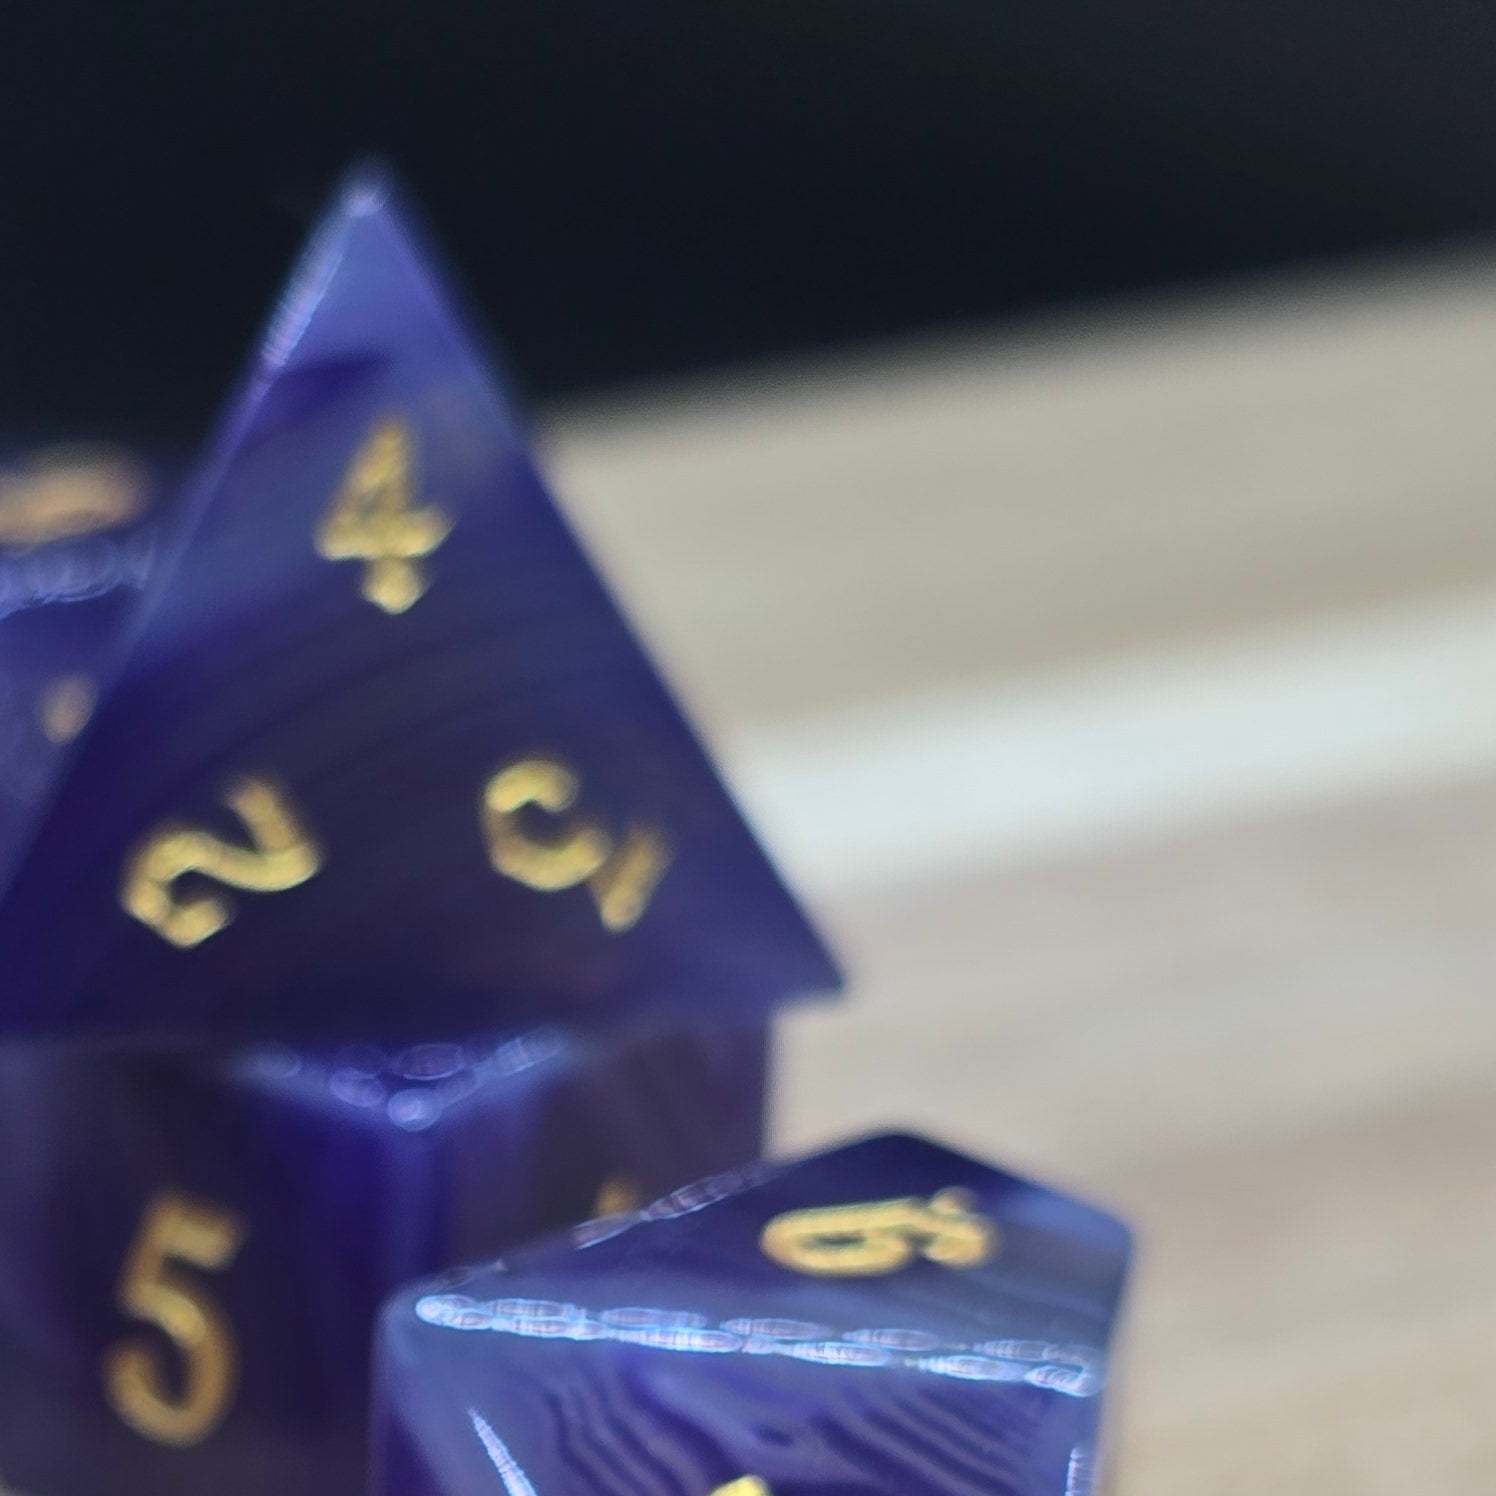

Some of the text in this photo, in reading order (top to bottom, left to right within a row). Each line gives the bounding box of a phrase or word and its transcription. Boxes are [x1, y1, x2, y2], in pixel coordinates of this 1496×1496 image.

[316, 415, 454, 615] 4
[120, 778, 322, 948] 2
[106, 1195, 244, 1446] 5
